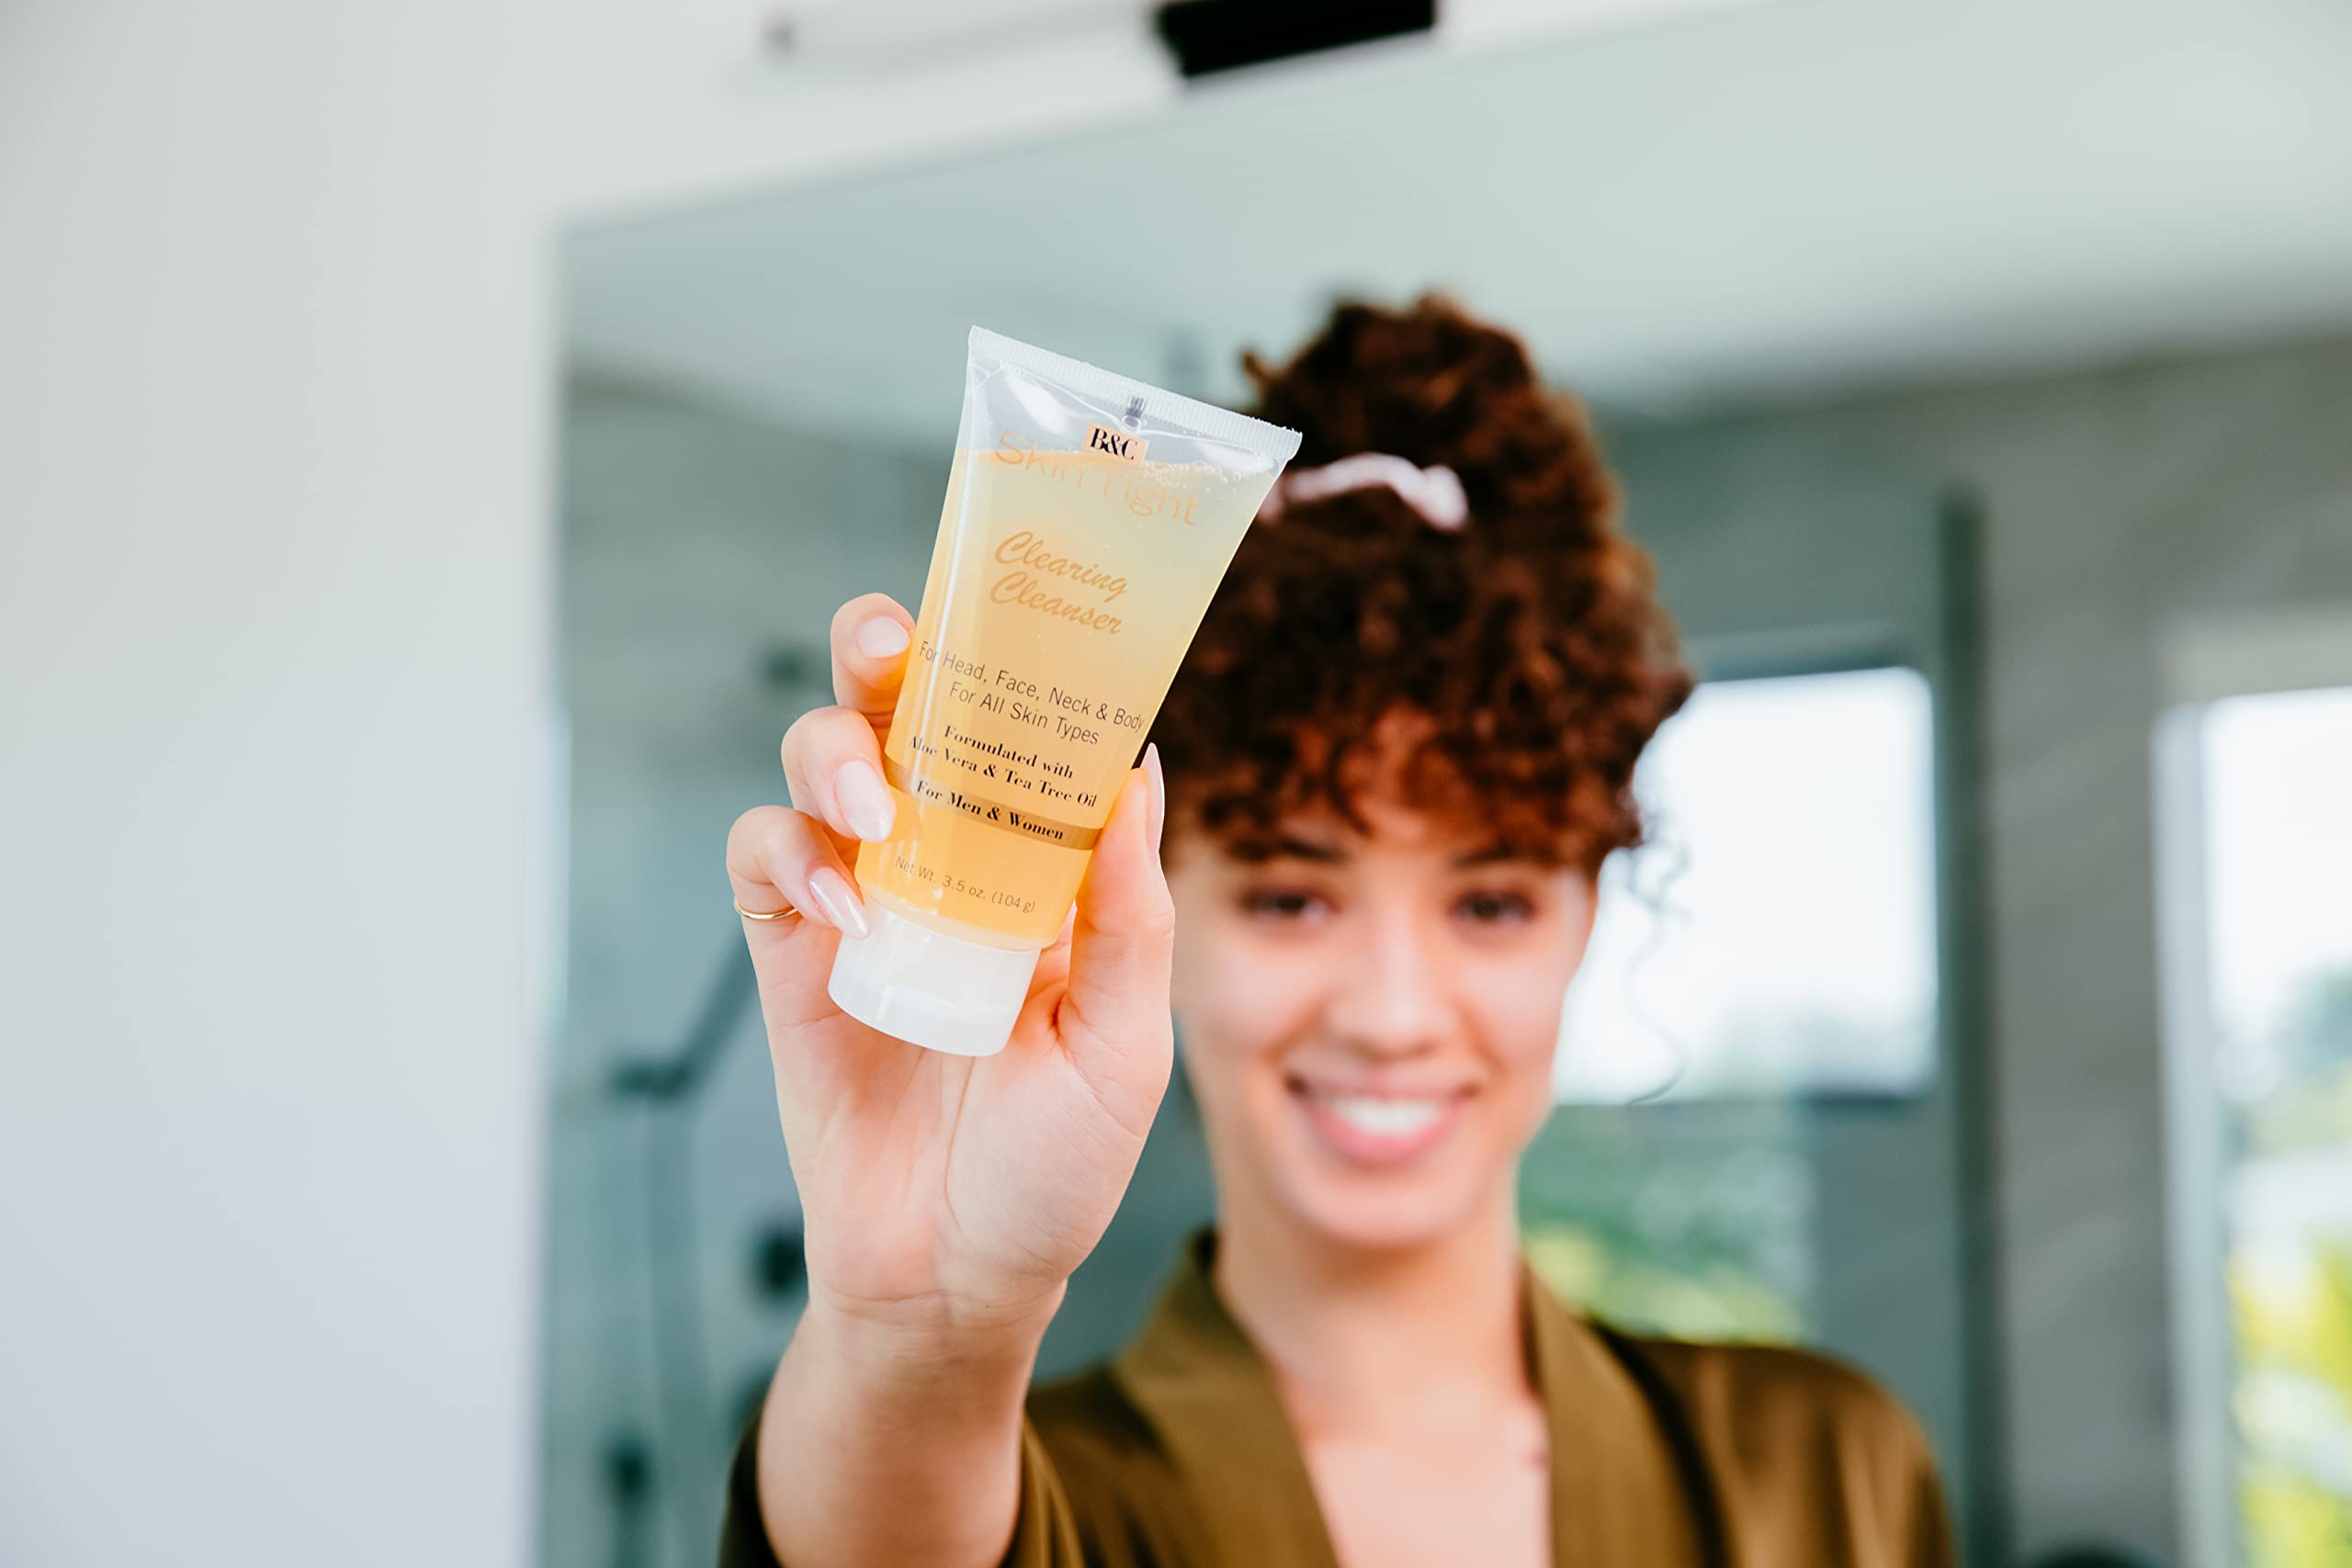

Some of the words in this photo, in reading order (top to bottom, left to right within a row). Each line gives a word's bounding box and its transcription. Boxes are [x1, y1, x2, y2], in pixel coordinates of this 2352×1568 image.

[994, 431, 1088, 487] Skin
[1090, 427, 1138, 460] B&C
[995, 531, 1128, 603] Clearing
[989, 571, 1122, 634] Cleanser
[919, 640, 939, 662] For
[943, 650, 987, 683] Head,
[995, 670, 1040, 702] Face,
[1048, 687, 1091, 716] Neck
[1096, 703, 1108, 720] &
[1114, 708, 1145, 734] Body
[949, 681, 977, 704] For
[979, 693, 1005, 715] All
[1010, 702, 1048, 728] Skin
[1056, 716, 1100, 745] Types
[909, 735, 937, 758] Aloe
[944, 748, 978, 772] Vera
[983, 763, 998, 778] &
[1005, 768, 1032, 790] Tea
[1039, 779, 1072, 802] Tree
[1077, 792, 1097, 808] Oil
[944, 725, 1037, 768] Formulated
[1043, 761, 1073, 780] with
[917, 780, 943, 800] For
[947, 791, 981, 816] Men
[987, 807, 1001, 821] &
[1008, 811, 1064, 840] Women
[895, 856, 915, 874] Net
[918, 866, 936, 884] Wt.
[942, 874, 966, 893] 3.5
[968, 886, 986, 899] oz.
[991, 891, 1021, 908] (104
[1022, 900, 1035, 914] g)
